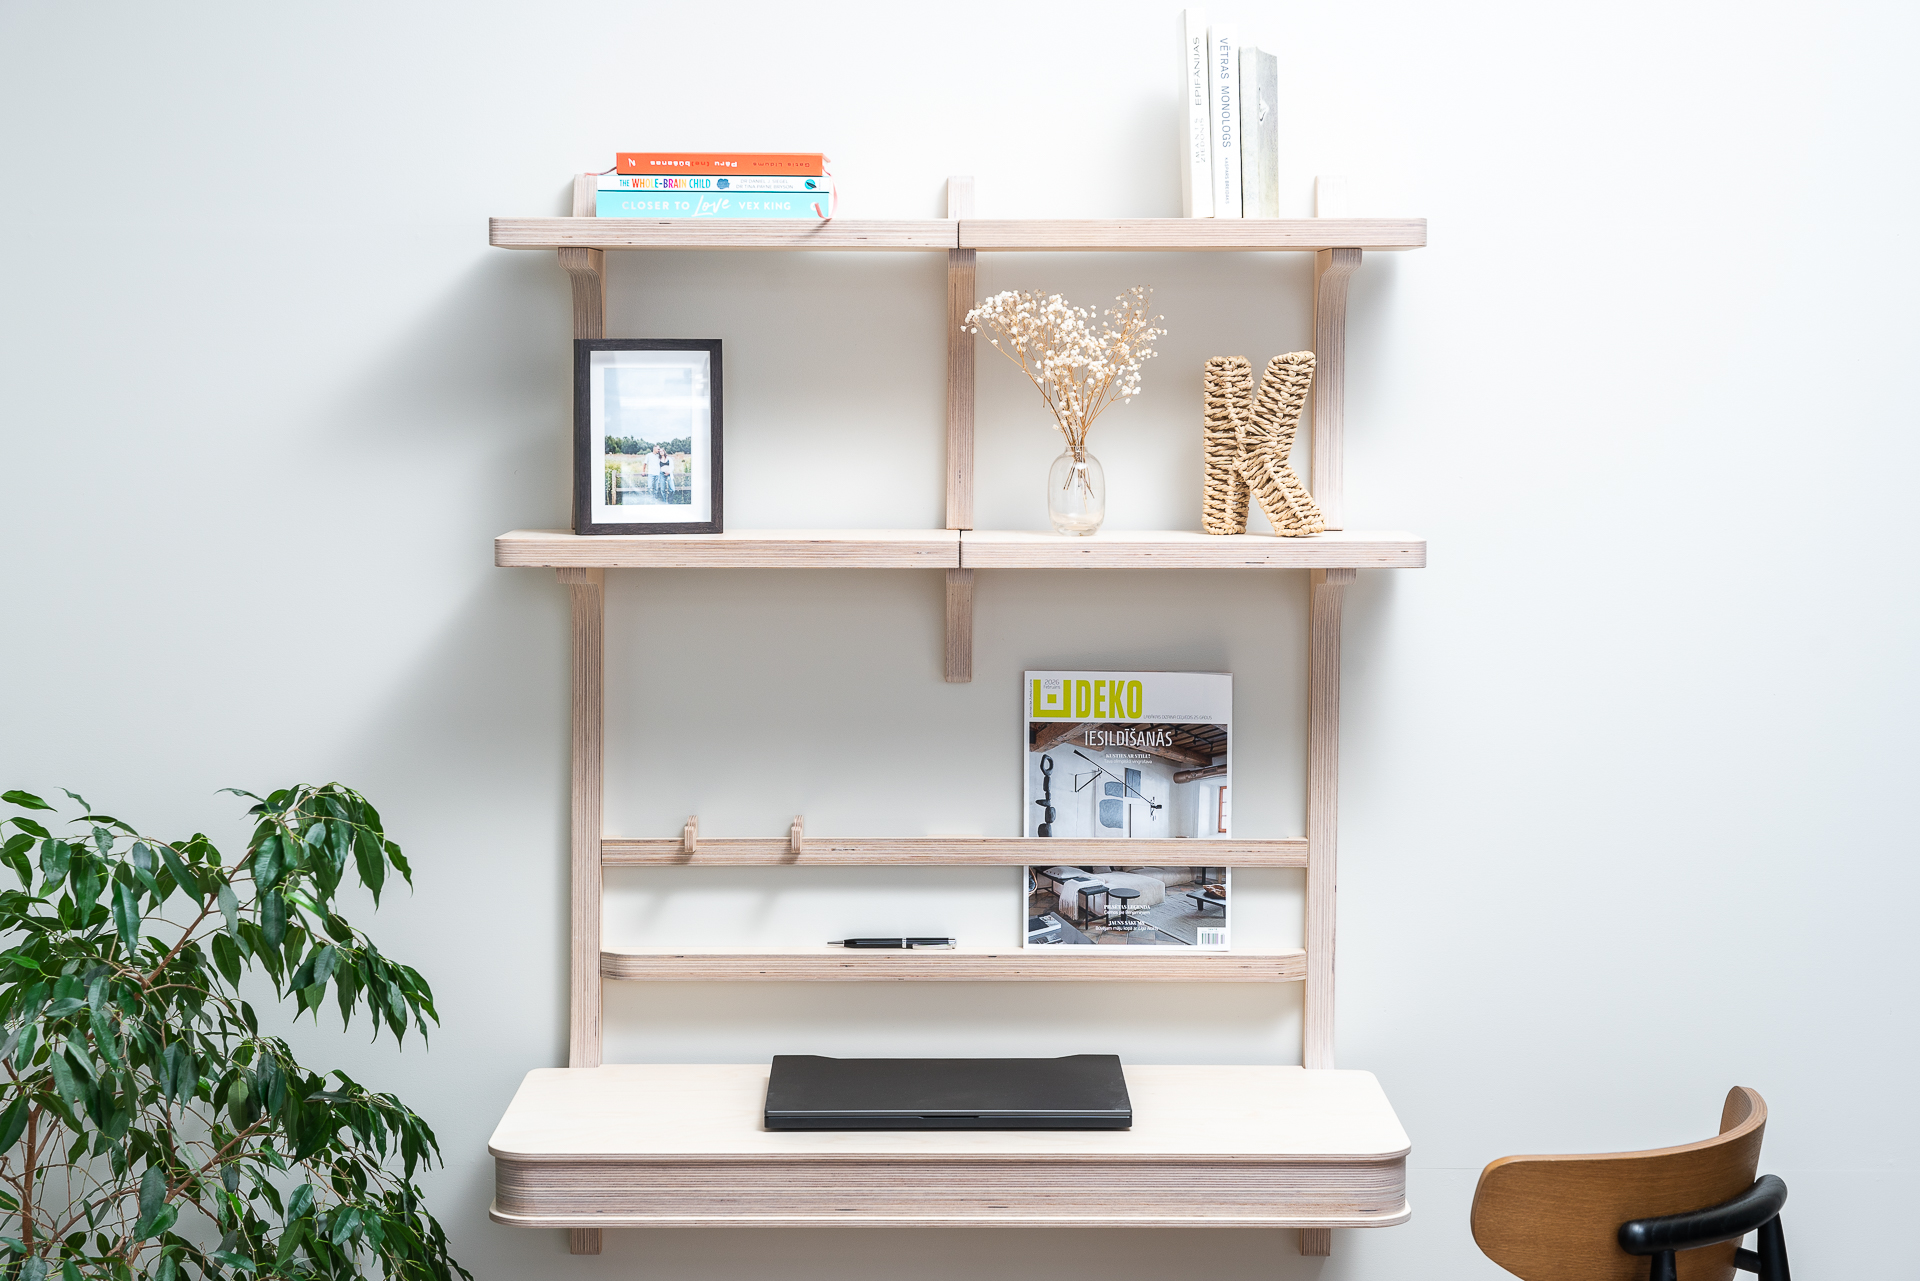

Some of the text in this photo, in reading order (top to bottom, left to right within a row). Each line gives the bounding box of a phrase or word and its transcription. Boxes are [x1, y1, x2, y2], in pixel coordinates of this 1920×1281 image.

[1193, 37, 1202, 106] EPIFĀNIJAS
[1220, 37, 1232, 148] VĒTRAS MONOLOGS
[619, 178, 711, 188] THE WHOLE-BRAIN CHILD
[622, 195, 791, 217] CLOSER TO Love VEX KING
[1201, 350, 1326, 538] K
[1076, 680, 1143, 719] DEKO
[1084, 728, 1173, 747] IESILDĪŠANĀS
